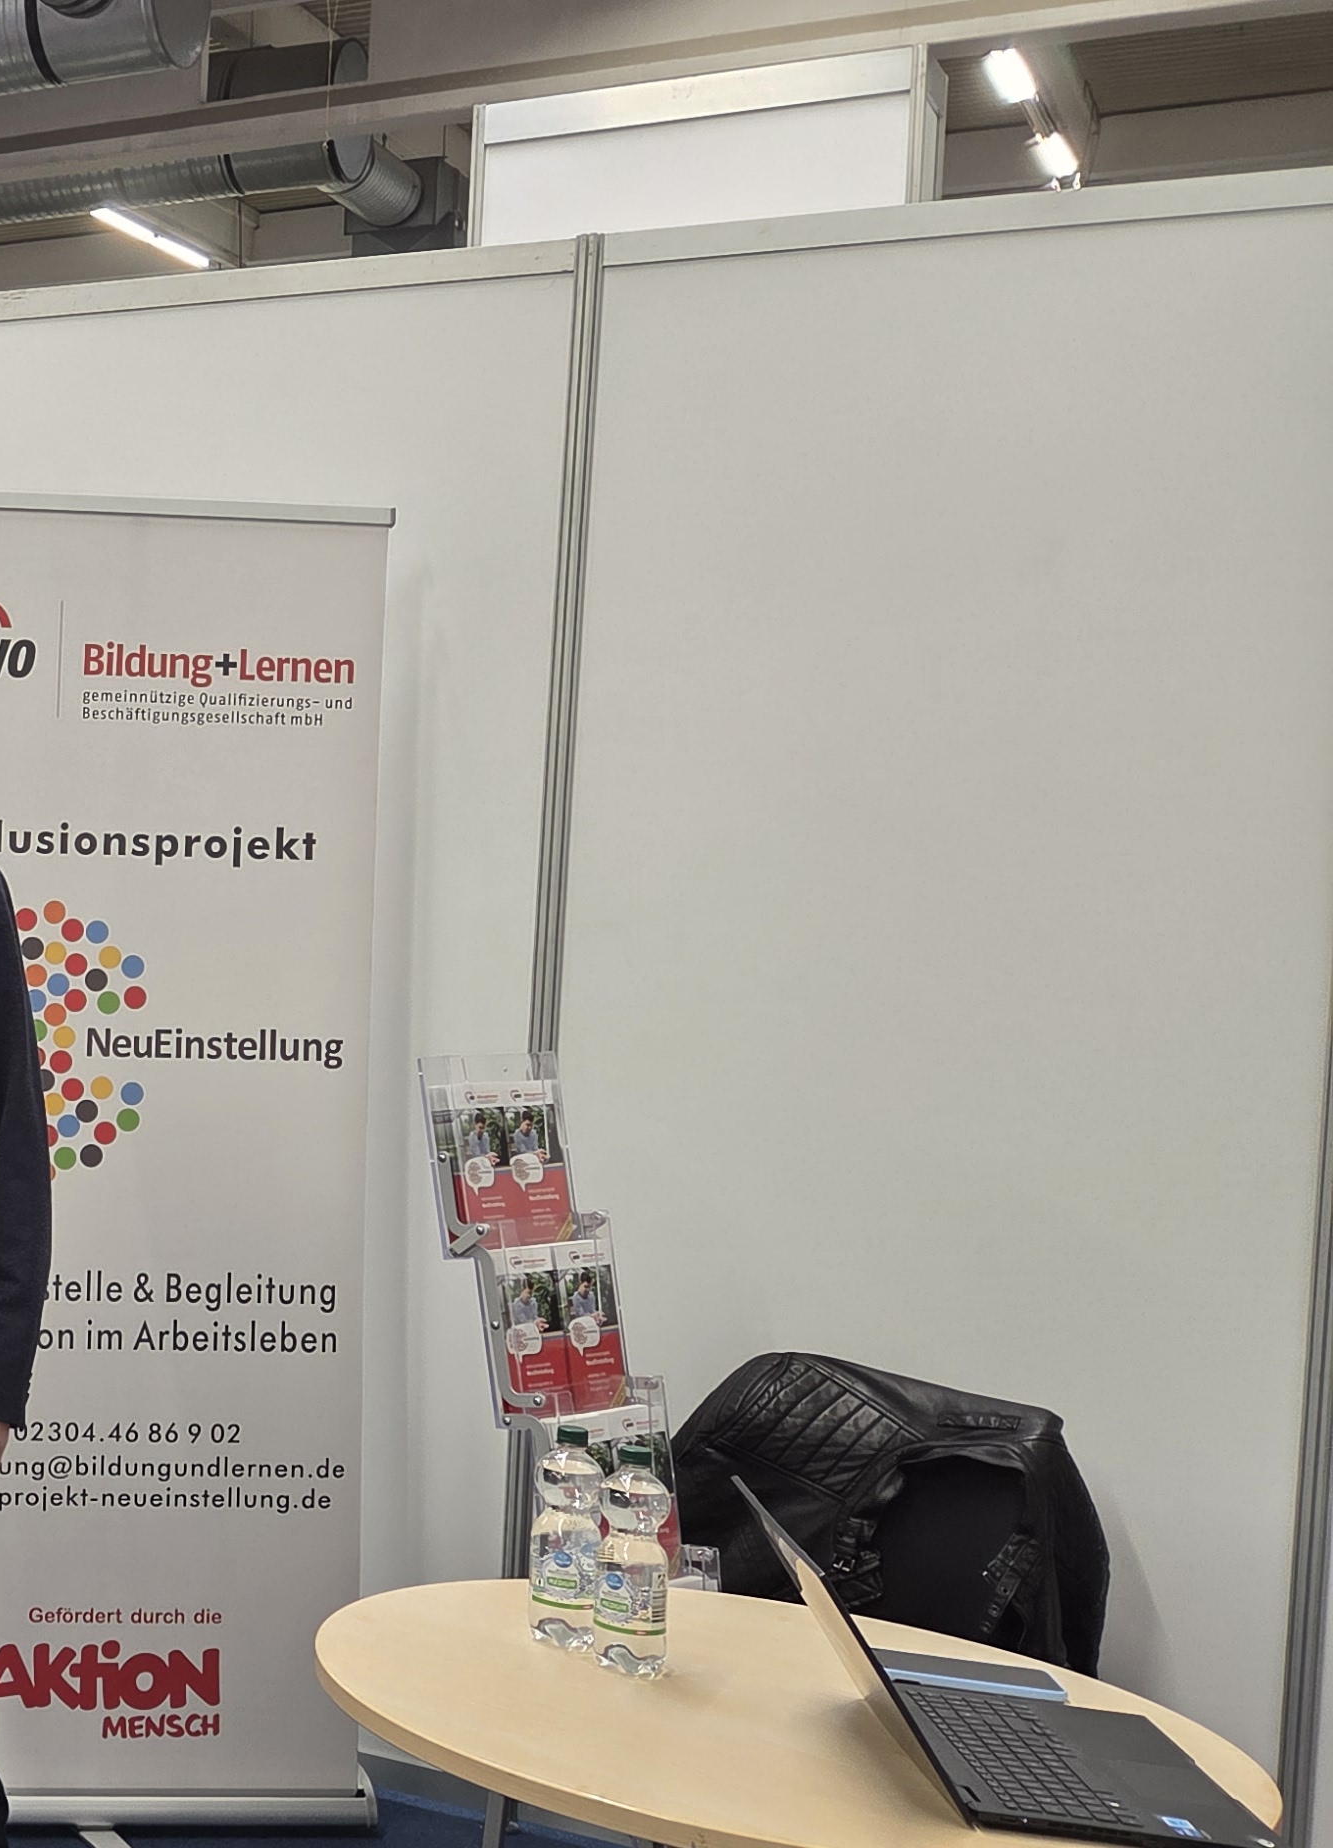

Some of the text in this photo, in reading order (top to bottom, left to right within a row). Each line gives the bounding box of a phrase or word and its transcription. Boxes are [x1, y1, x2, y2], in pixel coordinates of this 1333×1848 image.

[83, 641, 355, 687] Bildung+Lernen
[82, 690, 353, 711] gemeinnützige Qualifizierungs- und
[82, 706, 323, 727] Beschäftigungsgesellschaft mbH
[86, 1028, 344, 1070] NeuEinstellung
[133, 1273, 155, 1303] &
[165, 1272, 336, 1313] Begleitung
[87, 1320, 123, 1350] im
[132, 1320, 337, 1353] Arbeitsleben
[14, 1421, 241, 1444] 02304.46 86 9 02
[28, 1606, 222, 1625] Gefördert durch die
[101, 1713, 220, 1739] MENSCH
